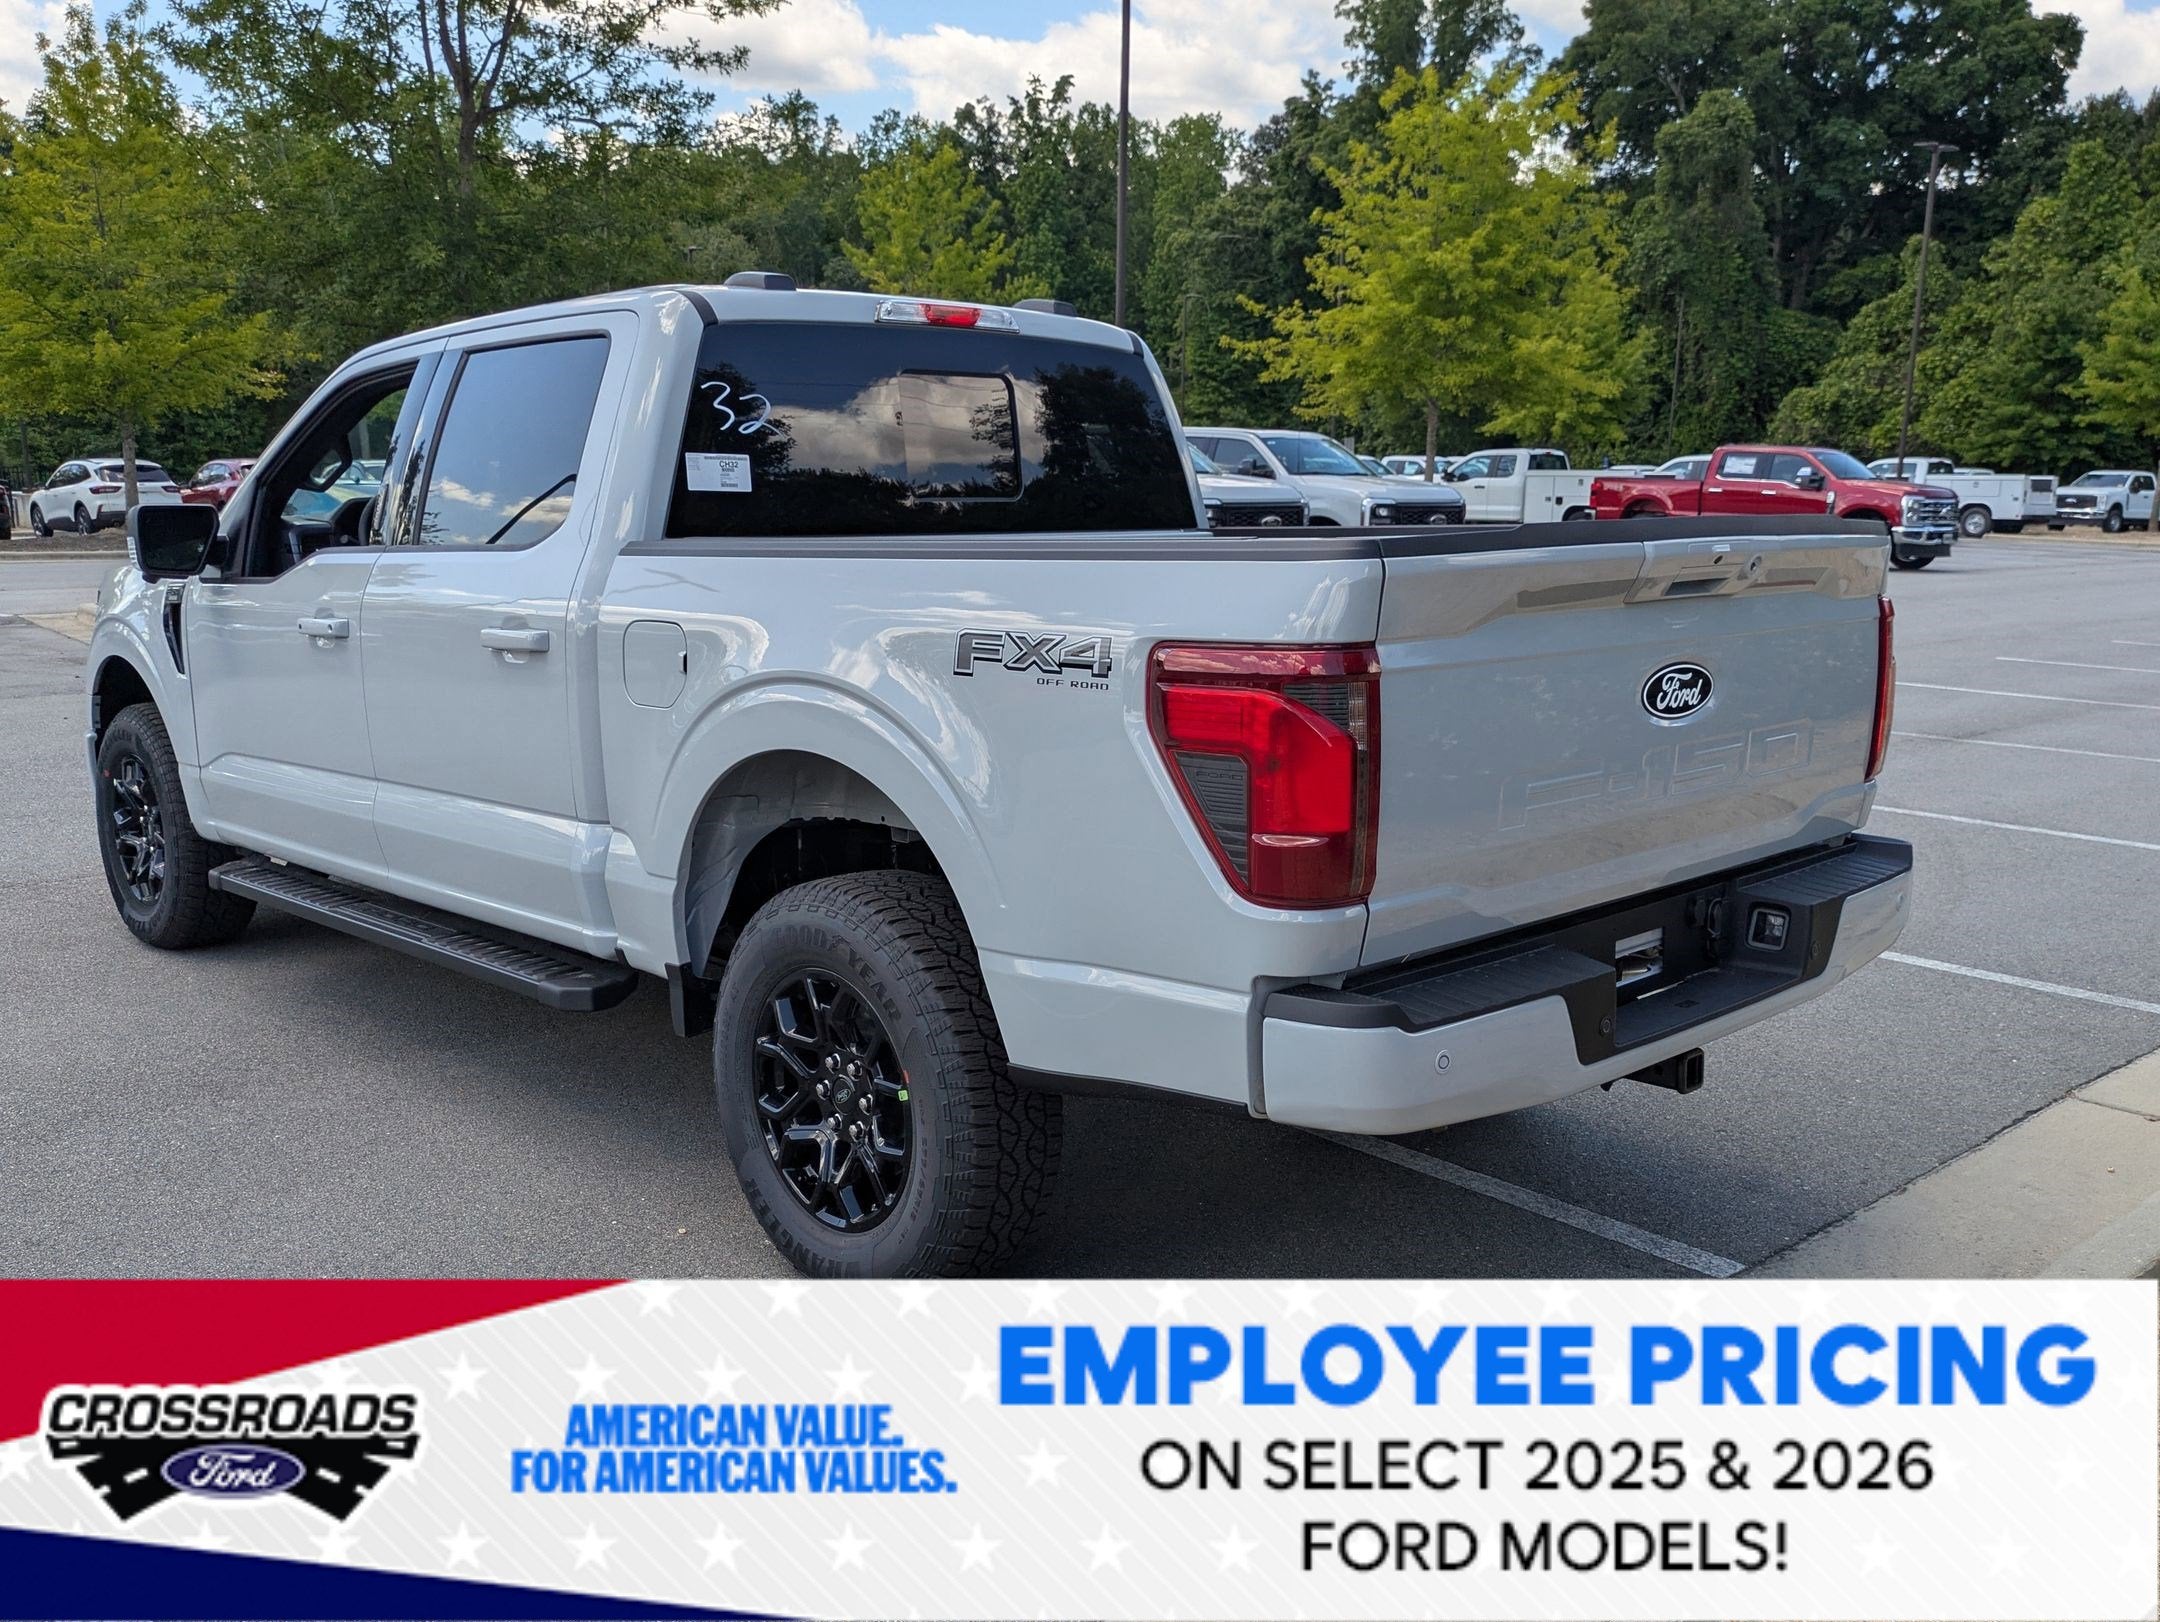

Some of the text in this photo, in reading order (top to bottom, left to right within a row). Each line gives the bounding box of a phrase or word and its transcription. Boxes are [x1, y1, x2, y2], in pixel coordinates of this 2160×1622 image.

[700, 381, 787, 440] 32
[953, 628, 1113, 678] FX4
[1036, 677, 1109, 690] OFF ROAD
[1656, 671, 1704, 711] Ford
